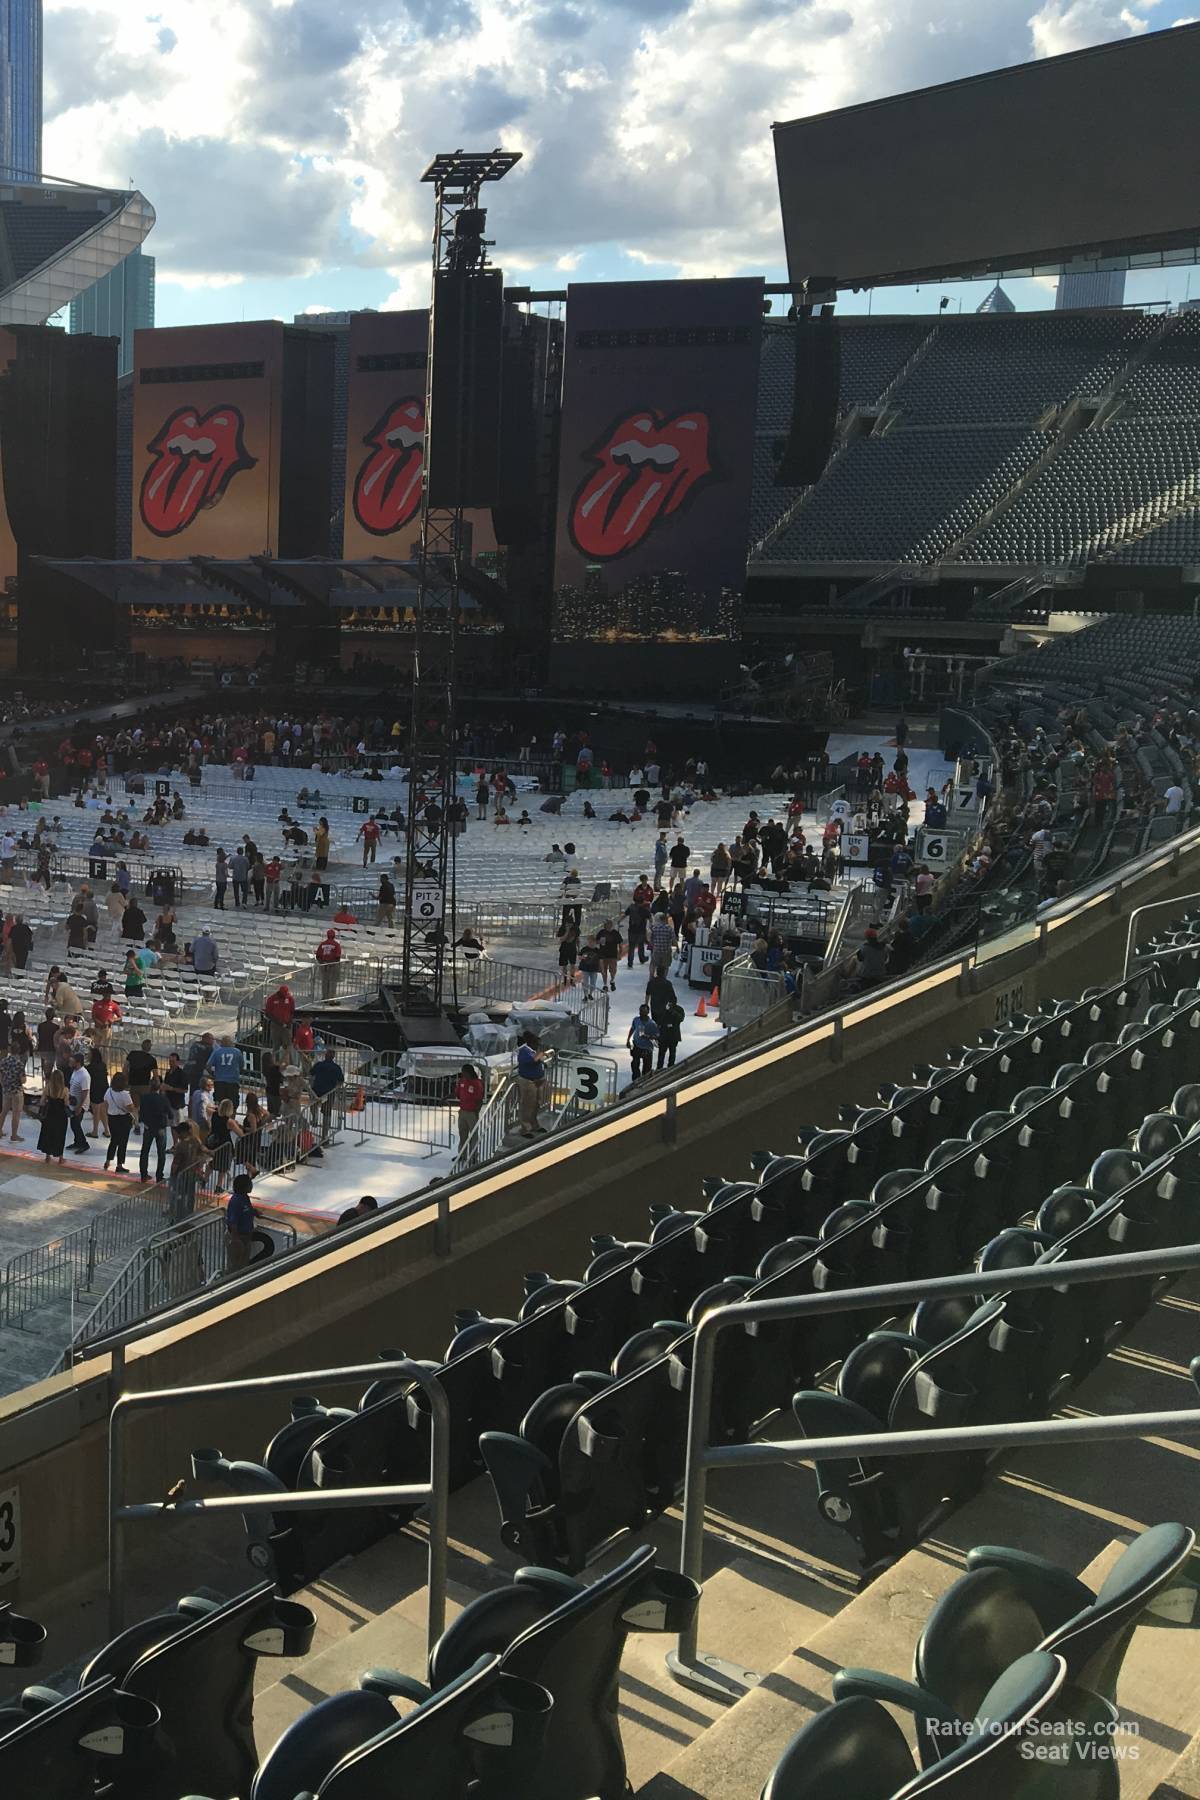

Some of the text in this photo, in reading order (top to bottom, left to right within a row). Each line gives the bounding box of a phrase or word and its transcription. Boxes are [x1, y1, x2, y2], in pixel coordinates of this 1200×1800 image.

[159, 783, 166, 794] B
[357, 800, 365, 811] B
[958, 791, 973, 808] 7
[927, 838, 944, 858] 6
[94, 863, 102, 877] F
[314, 886, 324, 902] A
[415, 892, 441, 902] PIT 2
[701, 950, 721, 961] Lite
[996, 994, 1008, 1021] 213
[220, 1053, 234, 1066] 17
[243, 1051, 254, 1072] H
[575, 1066, 599, 1101] 3
[513, 1531, 520, 1544] 2
